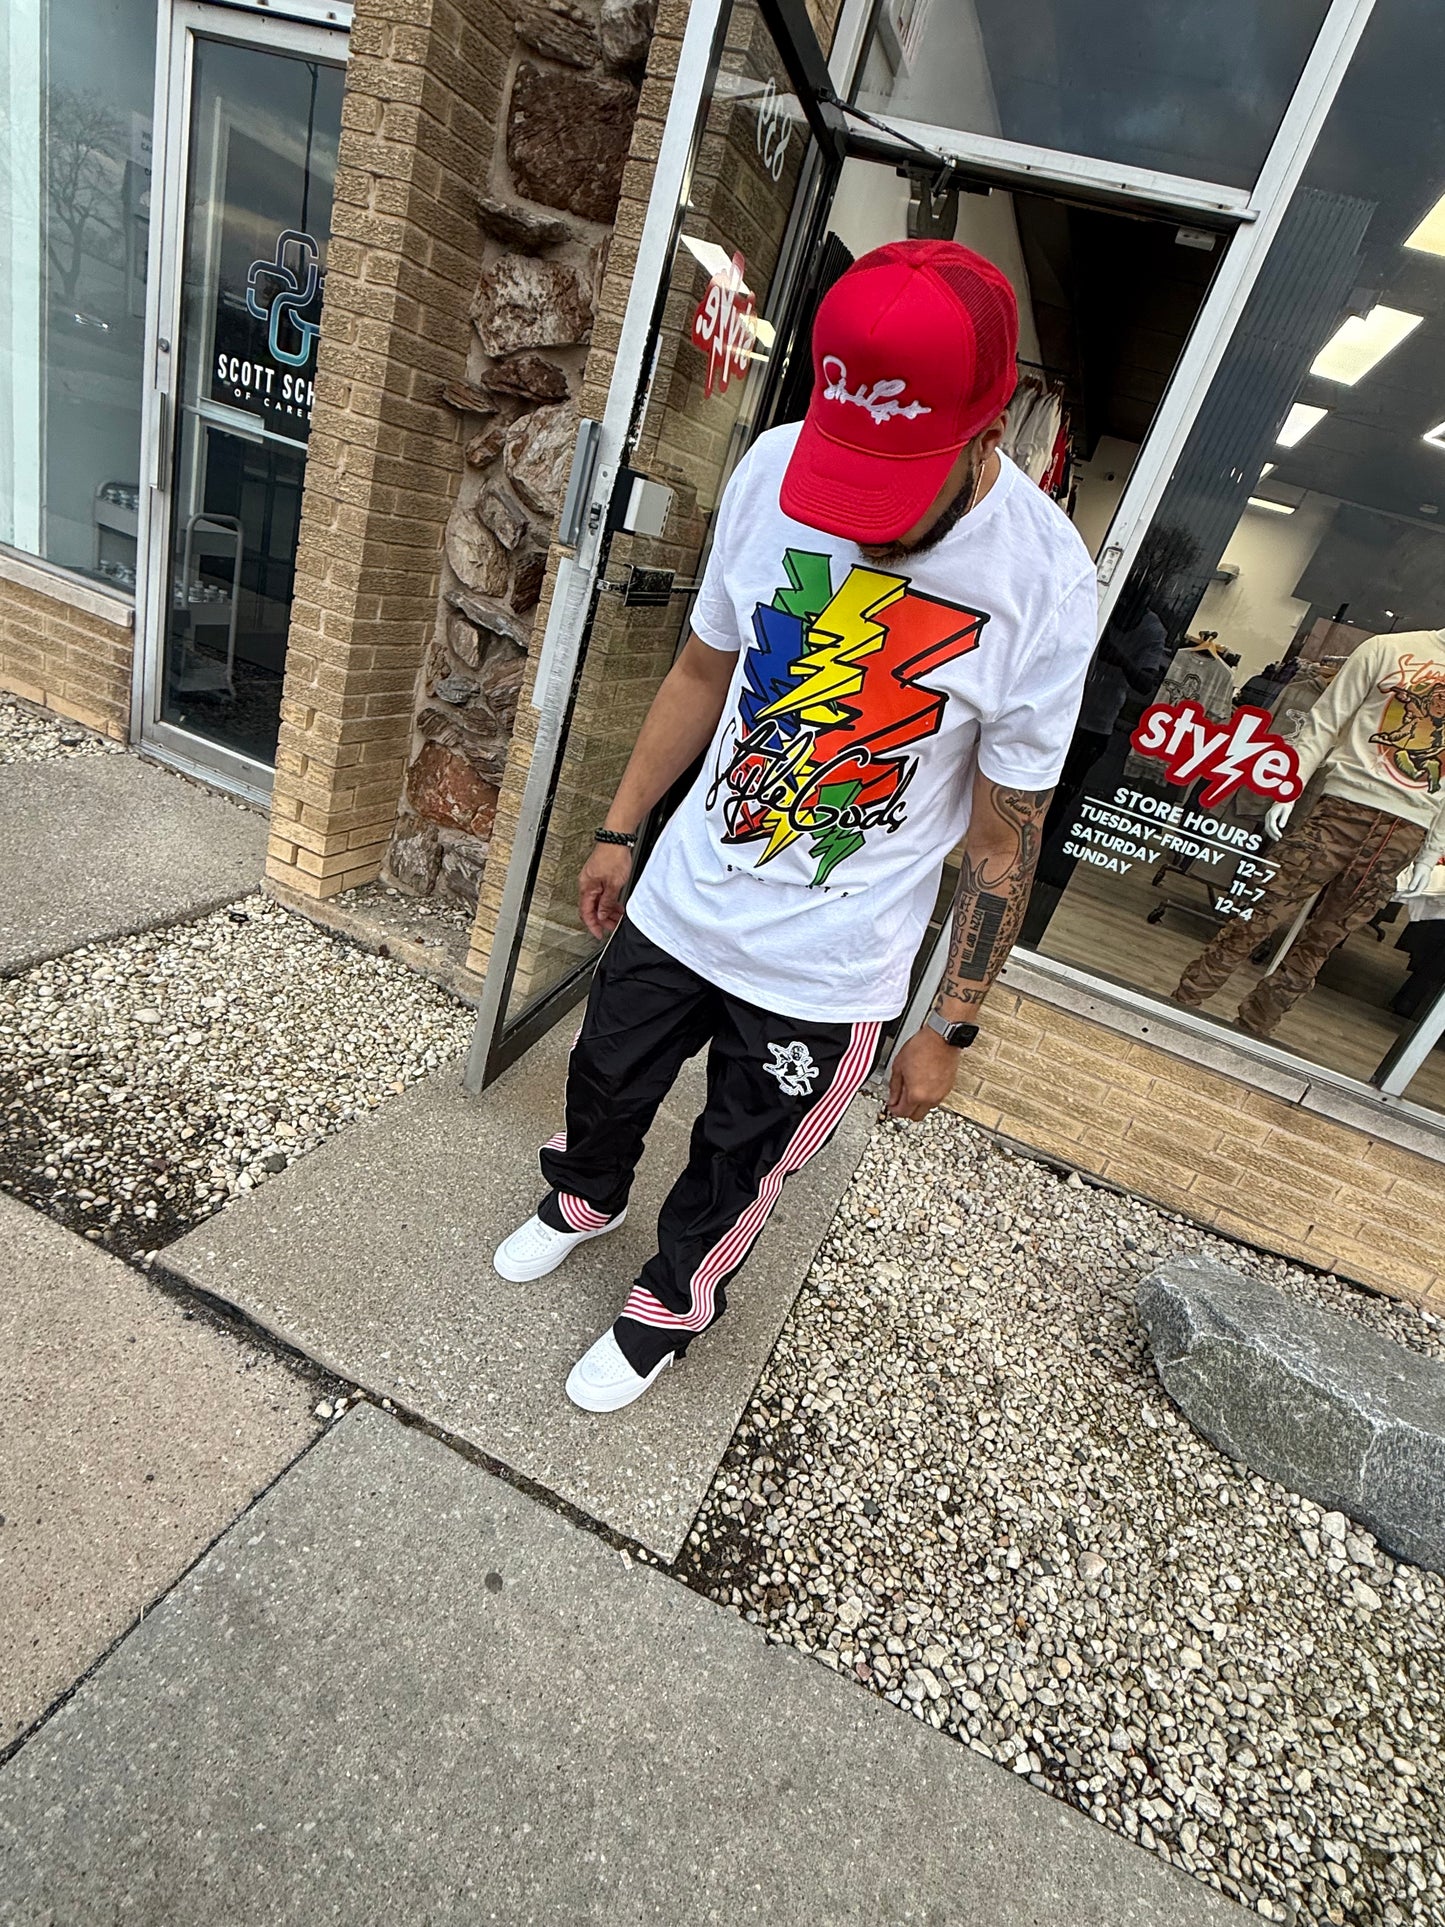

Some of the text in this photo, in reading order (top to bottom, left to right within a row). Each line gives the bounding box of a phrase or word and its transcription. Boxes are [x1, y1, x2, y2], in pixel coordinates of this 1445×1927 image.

[217, 353, 275, 393] SCOTT
[233, 388, 312, 420] OF CAREE
[1080, 803, 1277, 884] TUESDAY-FRIDAY 12-7
[1113, 787, 1263, 852] STORE HOURS
[1062, 841, 1255, 922] SUNDAY 12-4
[1070, 822, 1267, 903] SATURDAY 11-7
